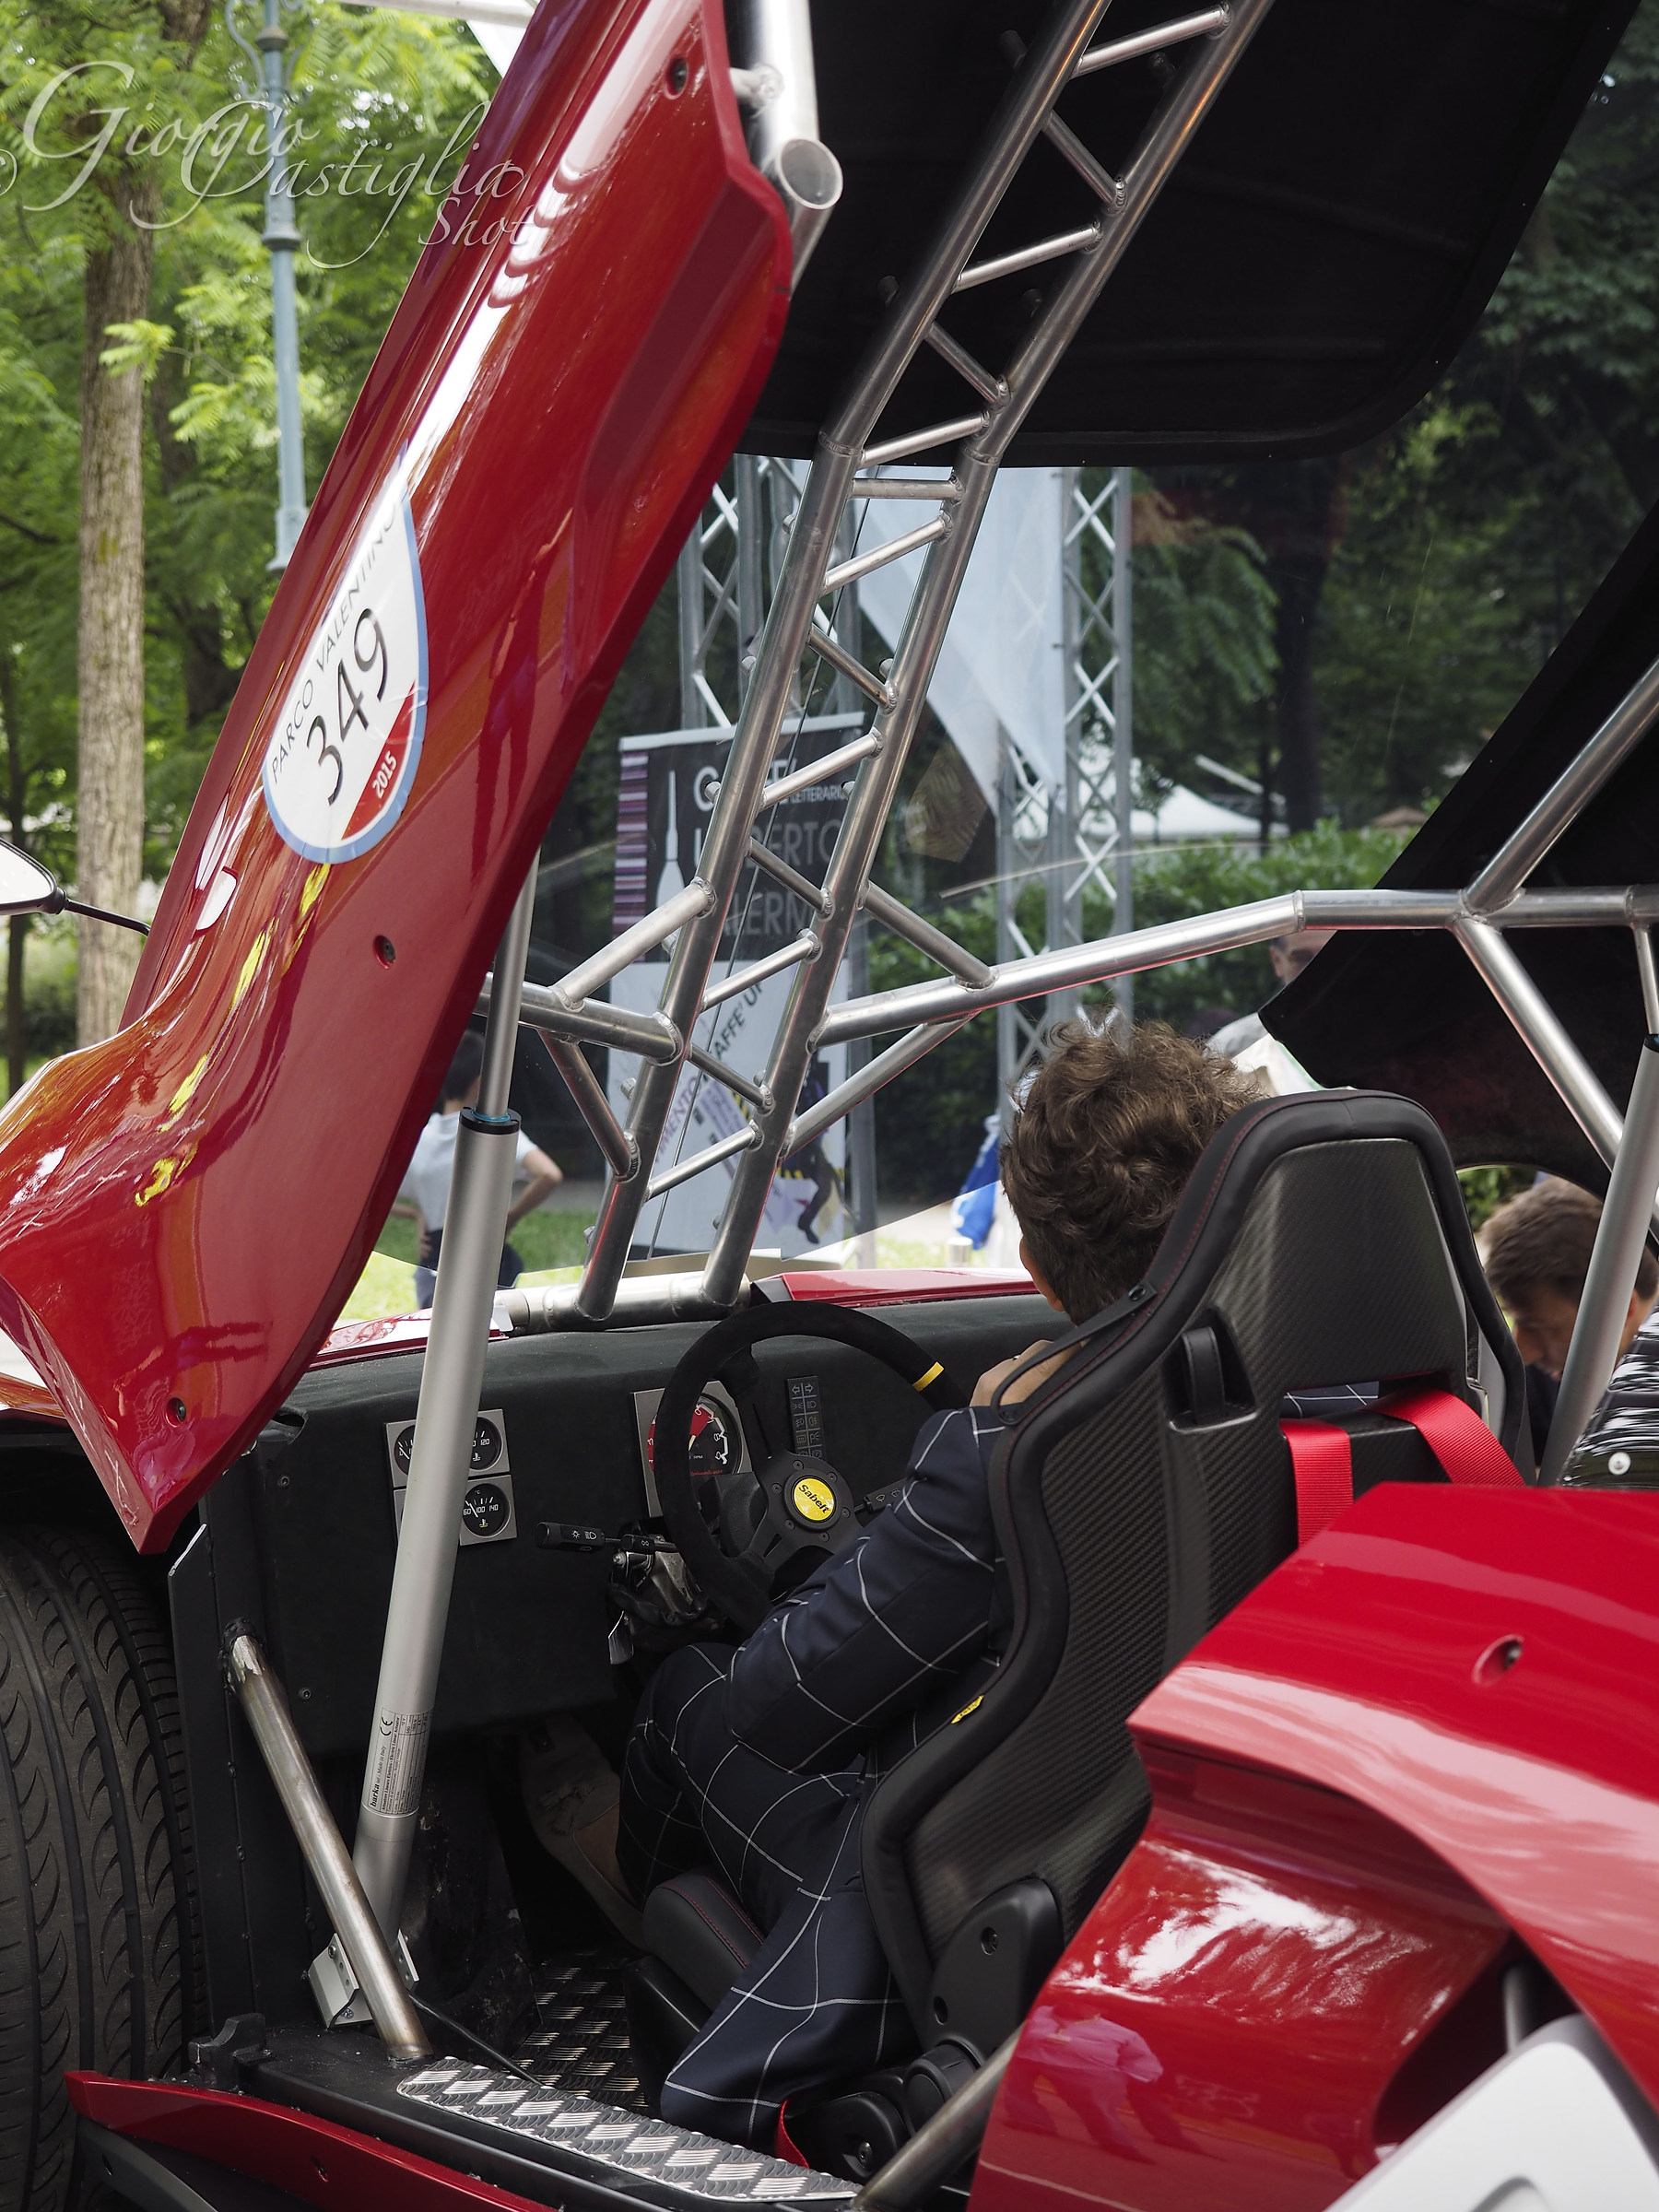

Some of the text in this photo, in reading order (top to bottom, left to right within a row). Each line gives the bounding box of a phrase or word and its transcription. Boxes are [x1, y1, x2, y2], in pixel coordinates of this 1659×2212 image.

[306, 607, 388, 806] 349
[272, 678, 313, 784] PARCO
[371, 749, 398, 799] 2015
[480, 1438, 490, 1446] 120
[463, 1508, 471, 1516] 60
[488, 1503, 499, 1512] 140
[798, 1483, 830, 1514] Sabelt
[380, 1717, 393, 1735] CE
[371, 1783, 380, 1807] barka
